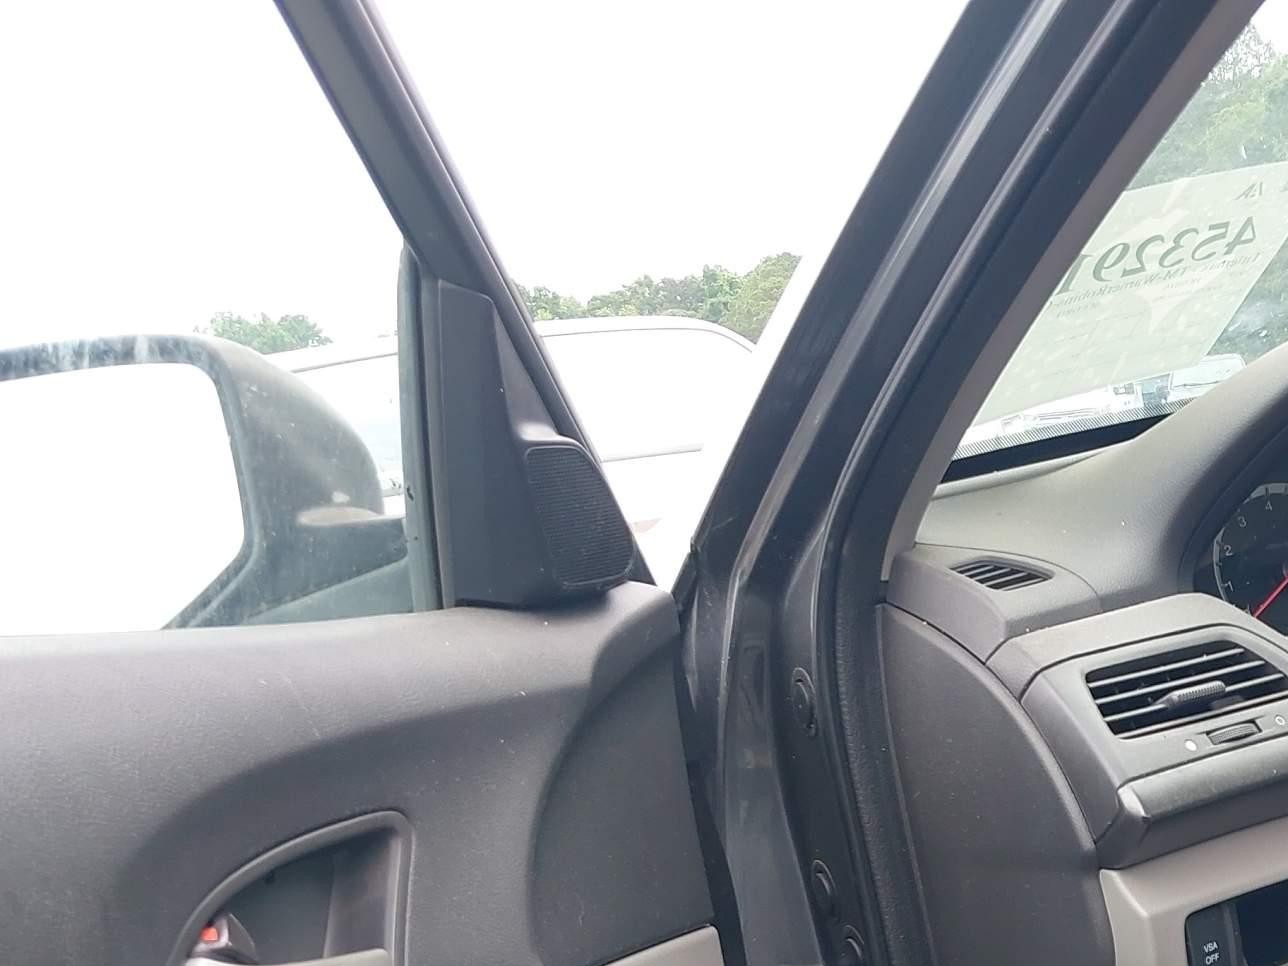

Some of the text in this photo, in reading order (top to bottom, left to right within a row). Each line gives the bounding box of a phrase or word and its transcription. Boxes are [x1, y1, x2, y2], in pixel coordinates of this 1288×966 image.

[1265, 501, 1273, 511] 4
[1237, 516, 1247, 528] 3
[1224, 545, 1233, 556] 2
[1226, 580, 1234, 592] 1
[1203, 941, 1219, 953] VSA
[1205, 953, 1220, 965] OFF
